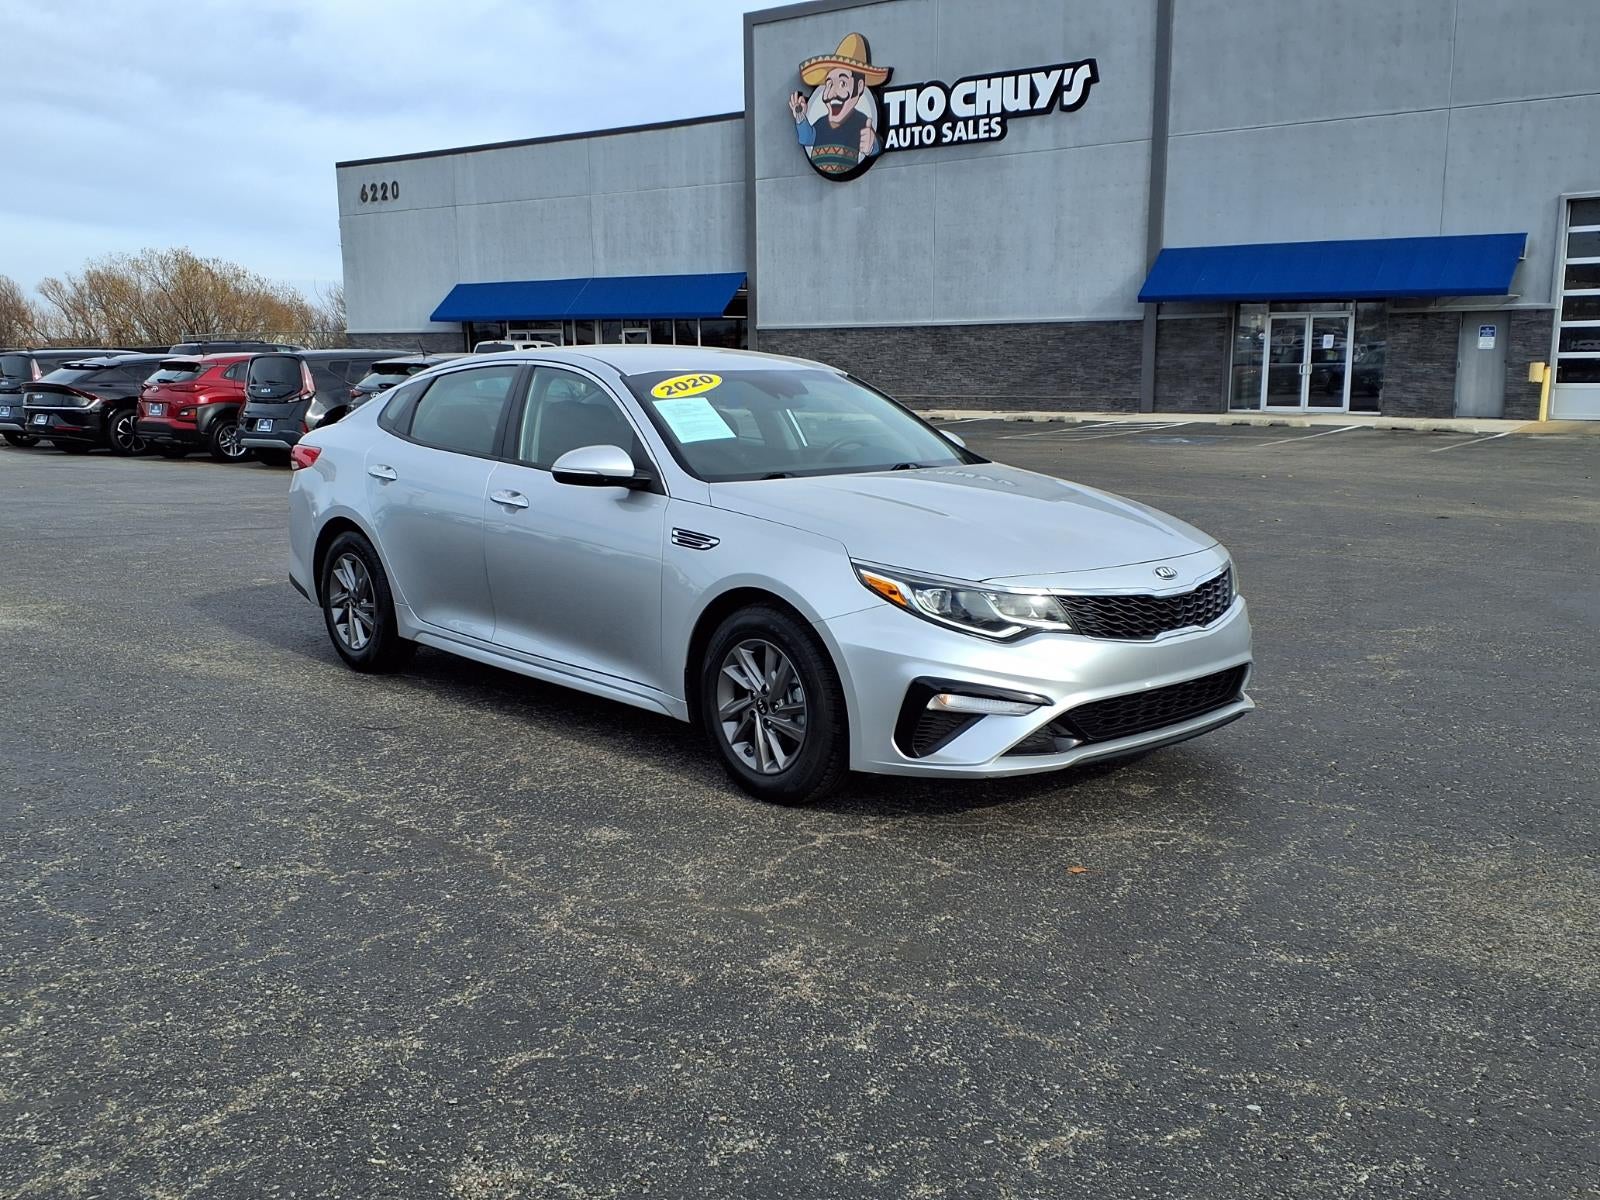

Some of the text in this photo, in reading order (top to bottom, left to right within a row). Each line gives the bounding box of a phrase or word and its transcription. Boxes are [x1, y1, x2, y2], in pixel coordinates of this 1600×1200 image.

[883, 64, 1092, 126] TIO CHUY'S
[885, 117, 1003, 149] AUTO SALES
[360, 180, 400, 203] 6220
[660, 375, 714, 397] 2020
